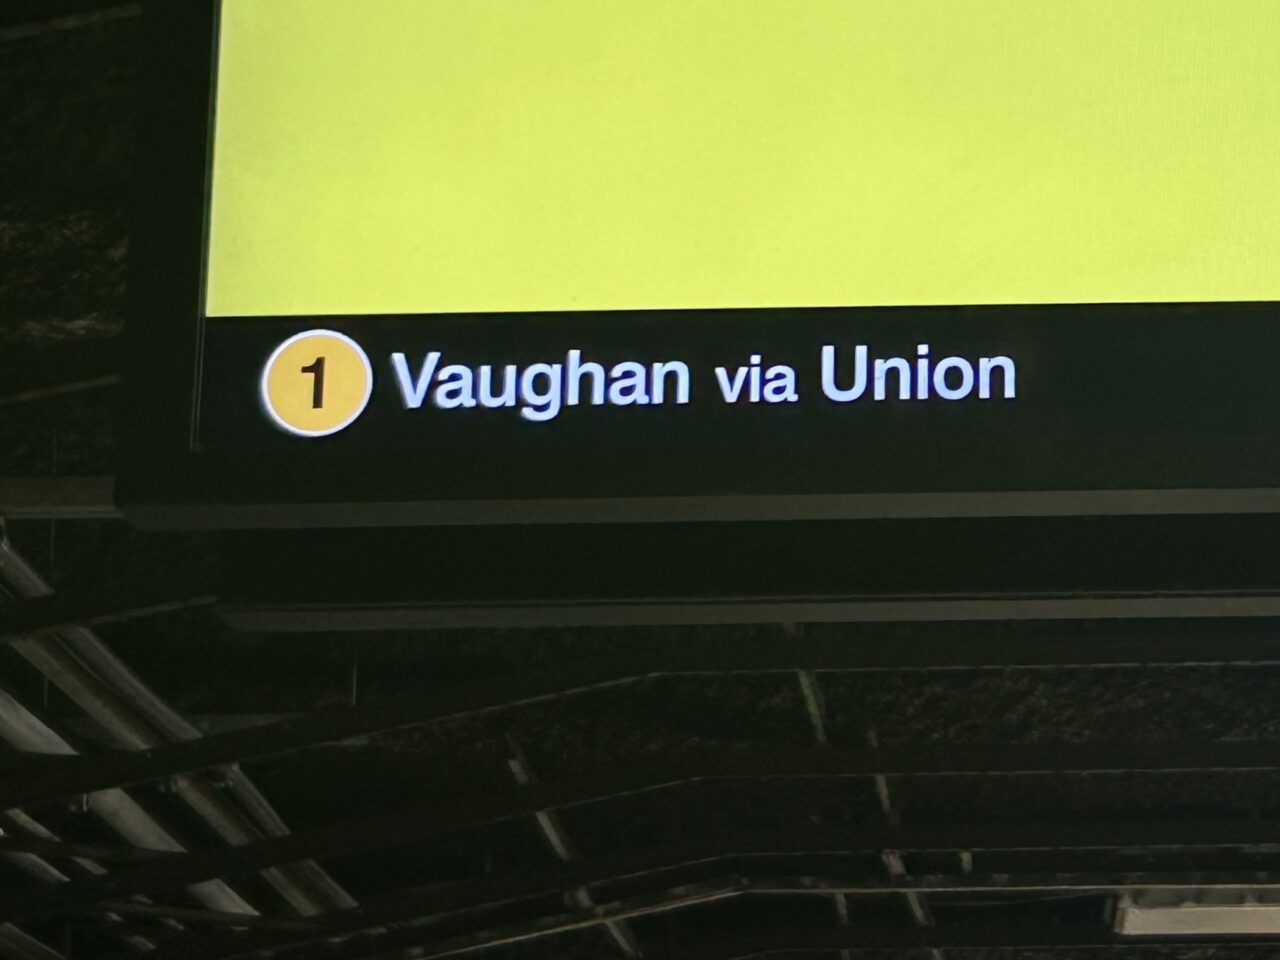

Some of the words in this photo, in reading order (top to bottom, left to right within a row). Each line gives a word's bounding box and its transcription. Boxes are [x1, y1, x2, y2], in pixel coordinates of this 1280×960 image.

[300, 356, 326, 410] 1
[391, 349, 690, 422] Vaughan
[714, 354, 799, 403] via
[820, 343, 1017, 402] Union
